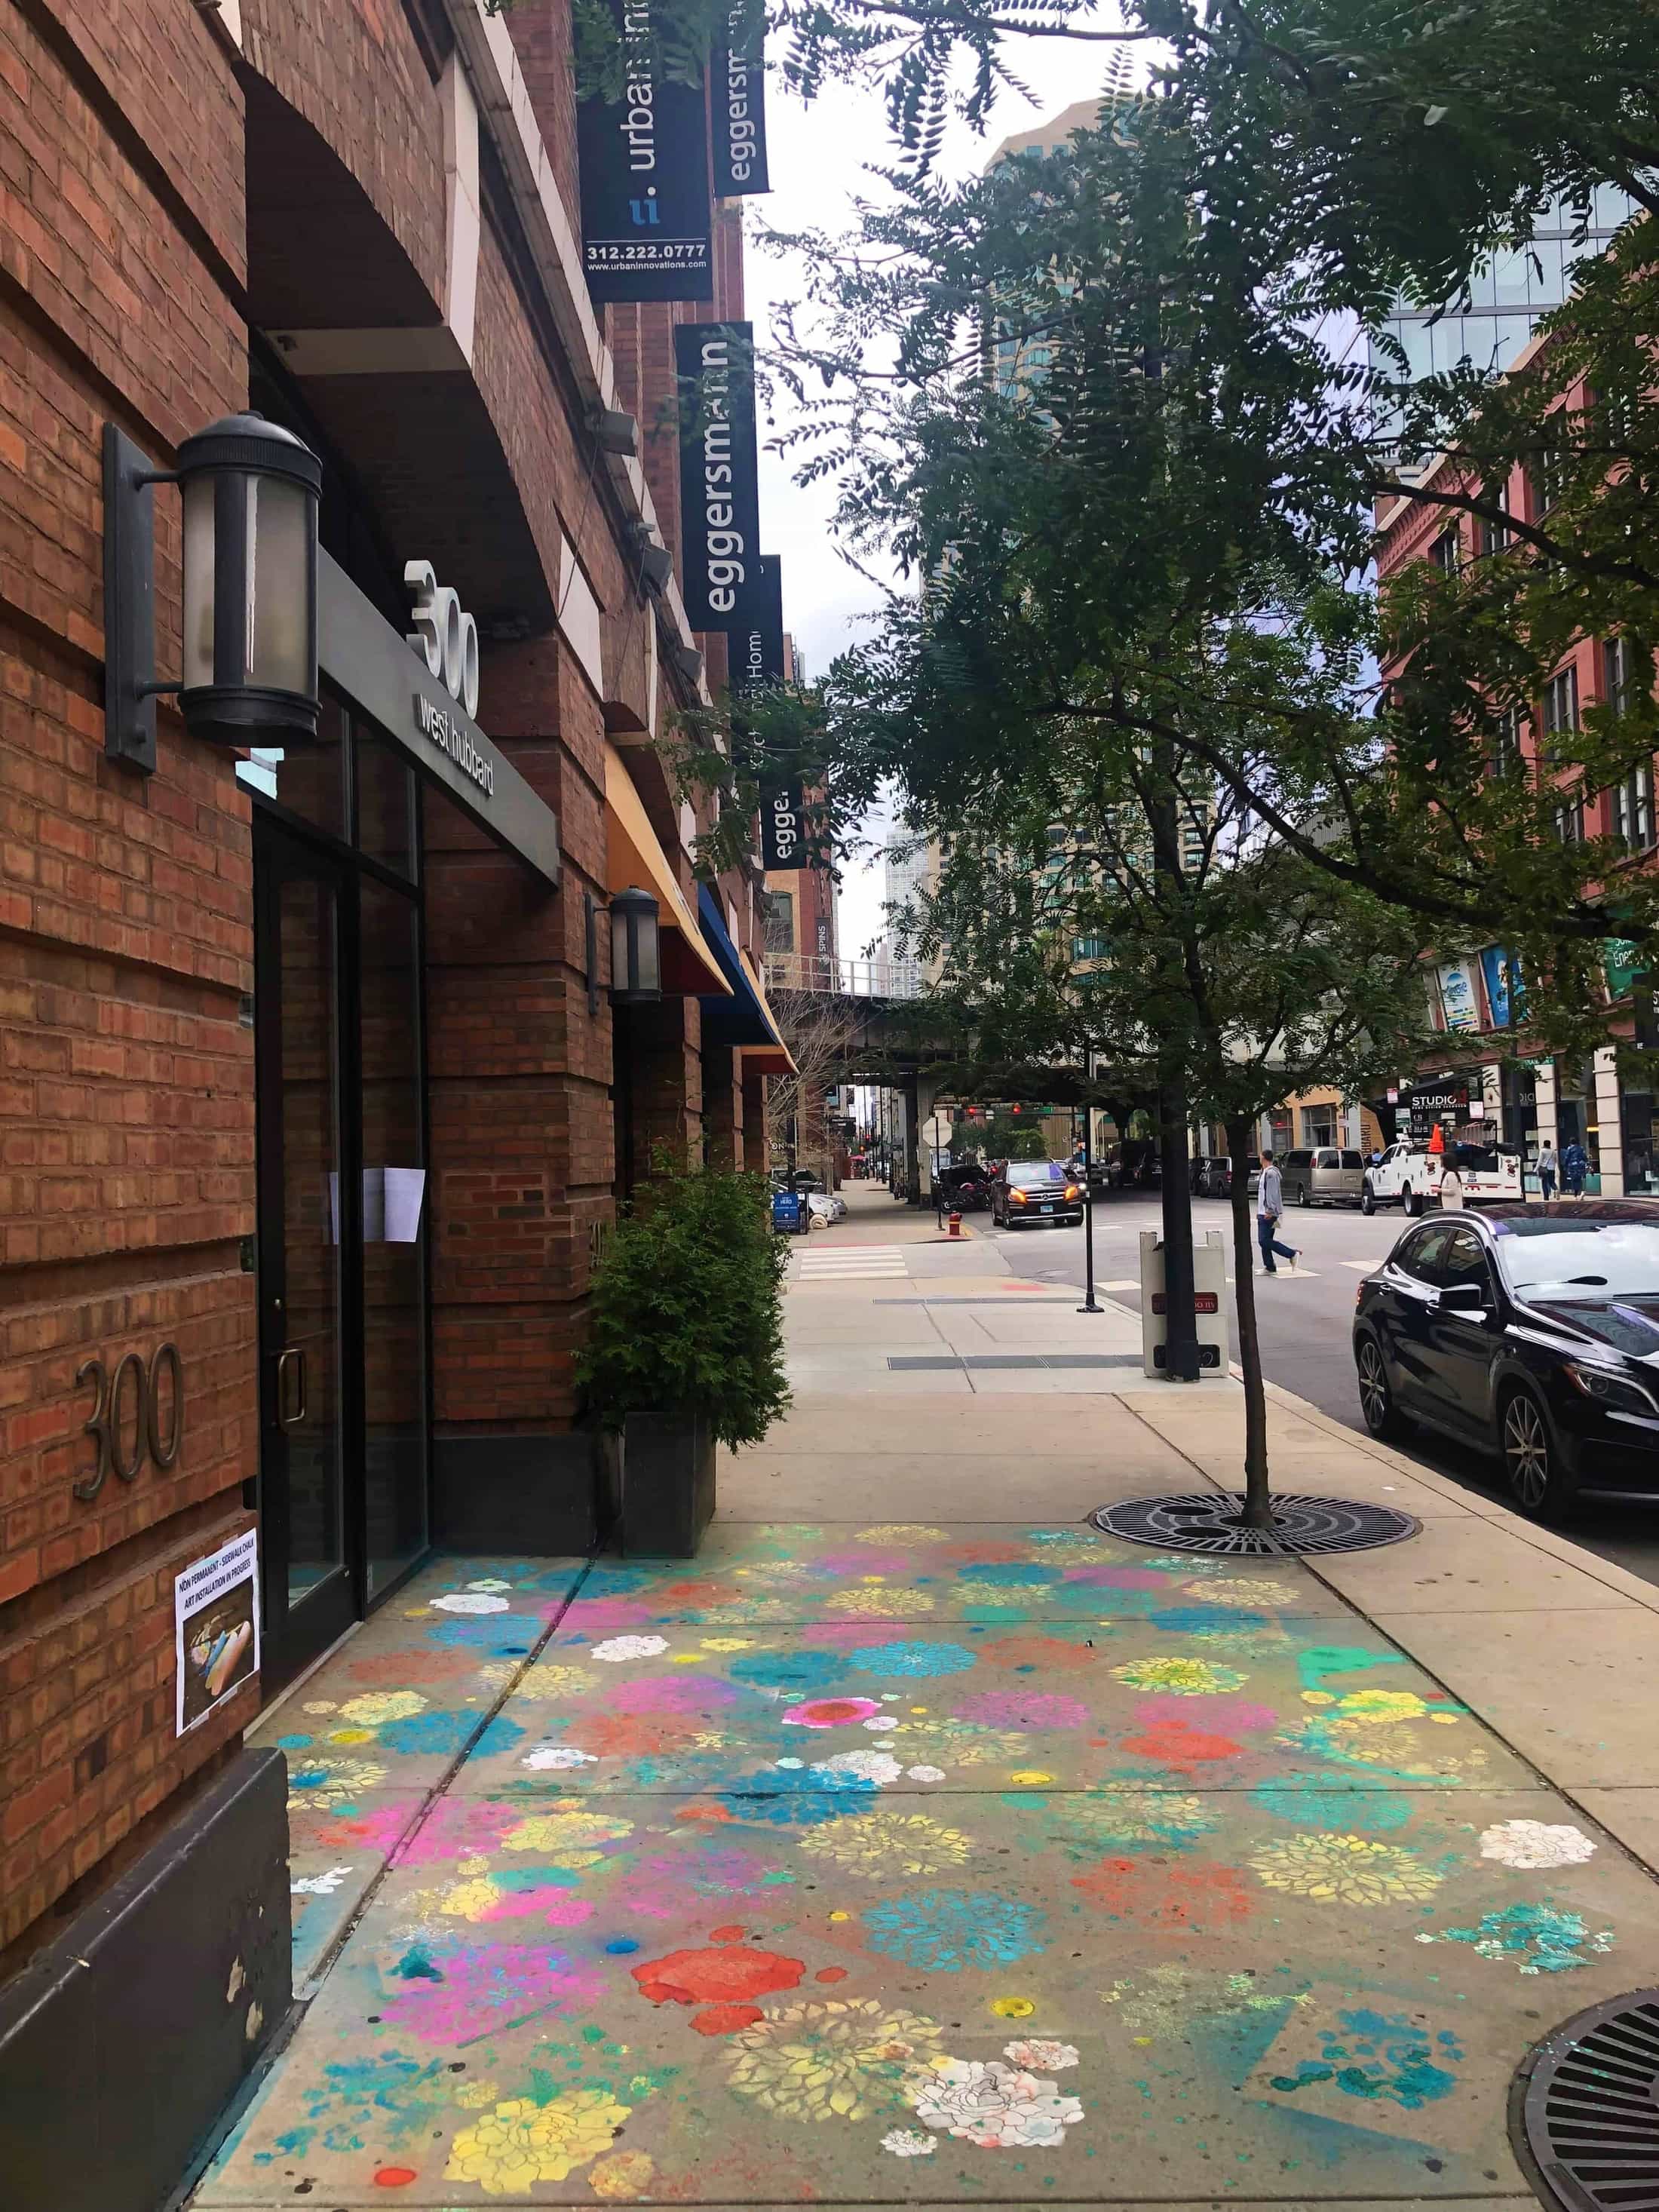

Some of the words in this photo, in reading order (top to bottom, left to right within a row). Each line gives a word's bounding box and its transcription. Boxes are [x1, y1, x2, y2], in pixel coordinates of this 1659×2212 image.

[587, 244, 706, 259] 312.222.0777
[587, 260, 707, 271] www.urbaninnovations.com
[404, 560, 479, 720] 300
[746, 629, 762, 678] Hom
[420, 693, 449, 753] west
[452, 718, 494, 797] hubbard
[818, 925, 826, 953] SPINS
[73, 1342, 182, 1500] 300
[179, 1578, 192, 1593] NON
[192, 1560, 219, 1586] PERMANENT
[222, 1547, 242, 1566] SIDEWALK
[242, 1537, 254, 1552] CHALK
[185, 1594, 195, 1609] ART
[195, 1575, 225, 1603] INSTALLATION
[226, 1570, 232, 1582] IN
[232, 1558, 251, 1578] PROGRESS
